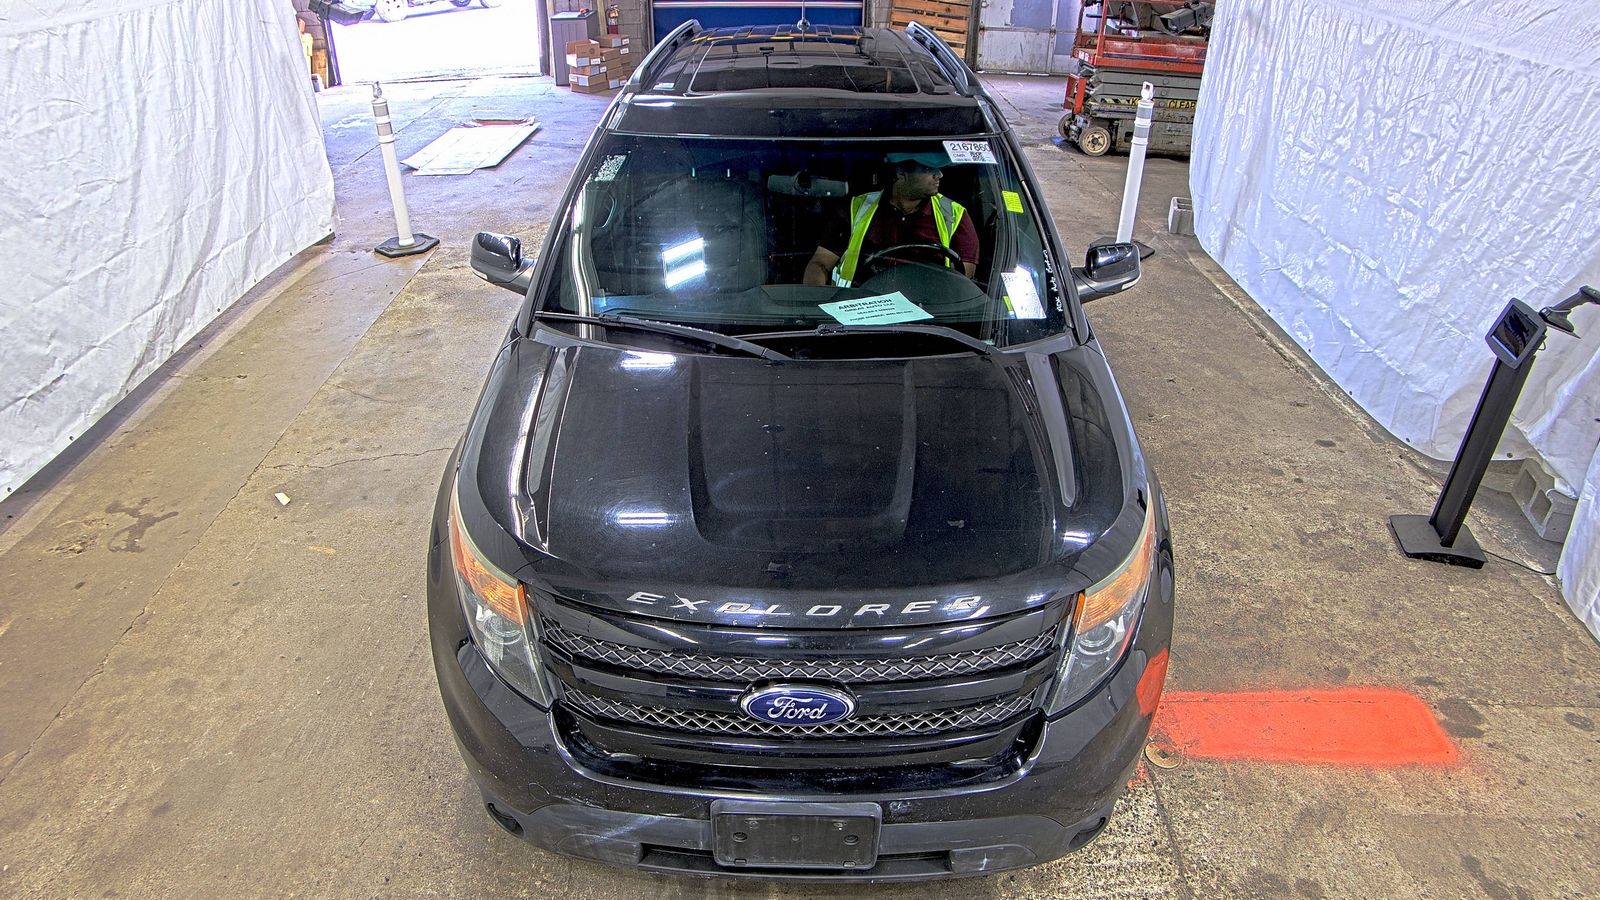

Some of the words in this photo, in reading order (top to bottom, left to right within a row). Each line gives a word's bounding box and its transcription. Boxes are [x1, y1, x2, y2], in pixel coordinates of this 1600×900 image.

[1168, 100, 1196, 109] CLEAR
[838, 298, 893, 310] ARBITRATION
[626, 590, 982, 617] EXPLORER
[767, 696, 828, 720] Ford
